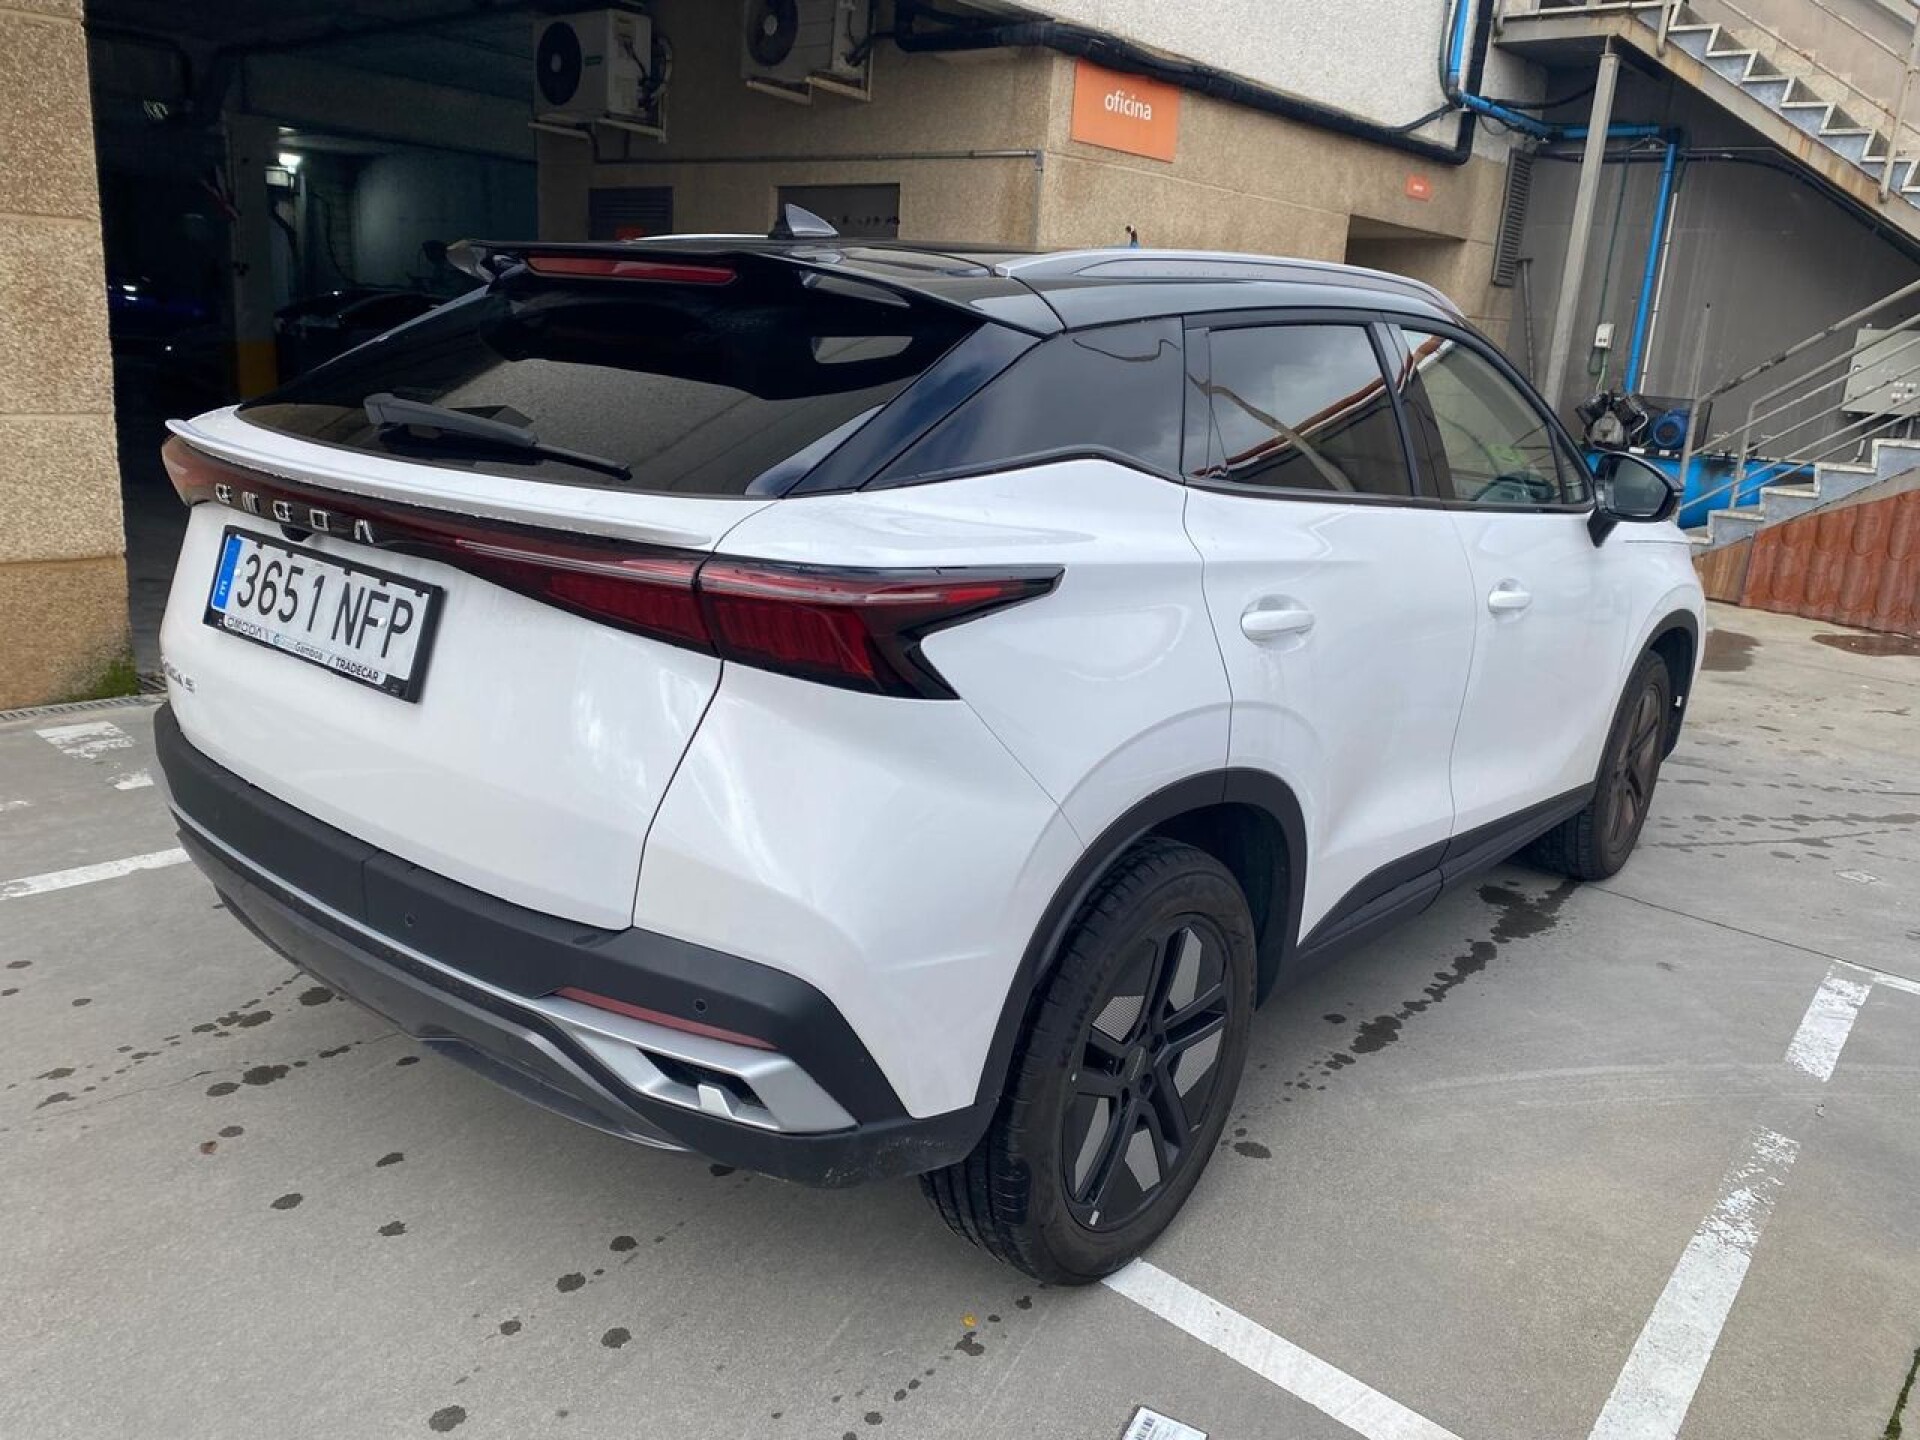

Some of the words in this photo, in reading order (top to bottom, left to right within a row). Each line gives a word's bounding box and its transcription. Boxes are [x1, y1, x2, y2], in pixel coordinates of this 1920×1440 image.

[1105, 90, 1152, 120] oficina
[218, 580, 227, 596] E
[237, 554, 325, 632] 3651
[331, 581, 414, 658] NFP
[335, 656, 379, 682] TRADECAR
